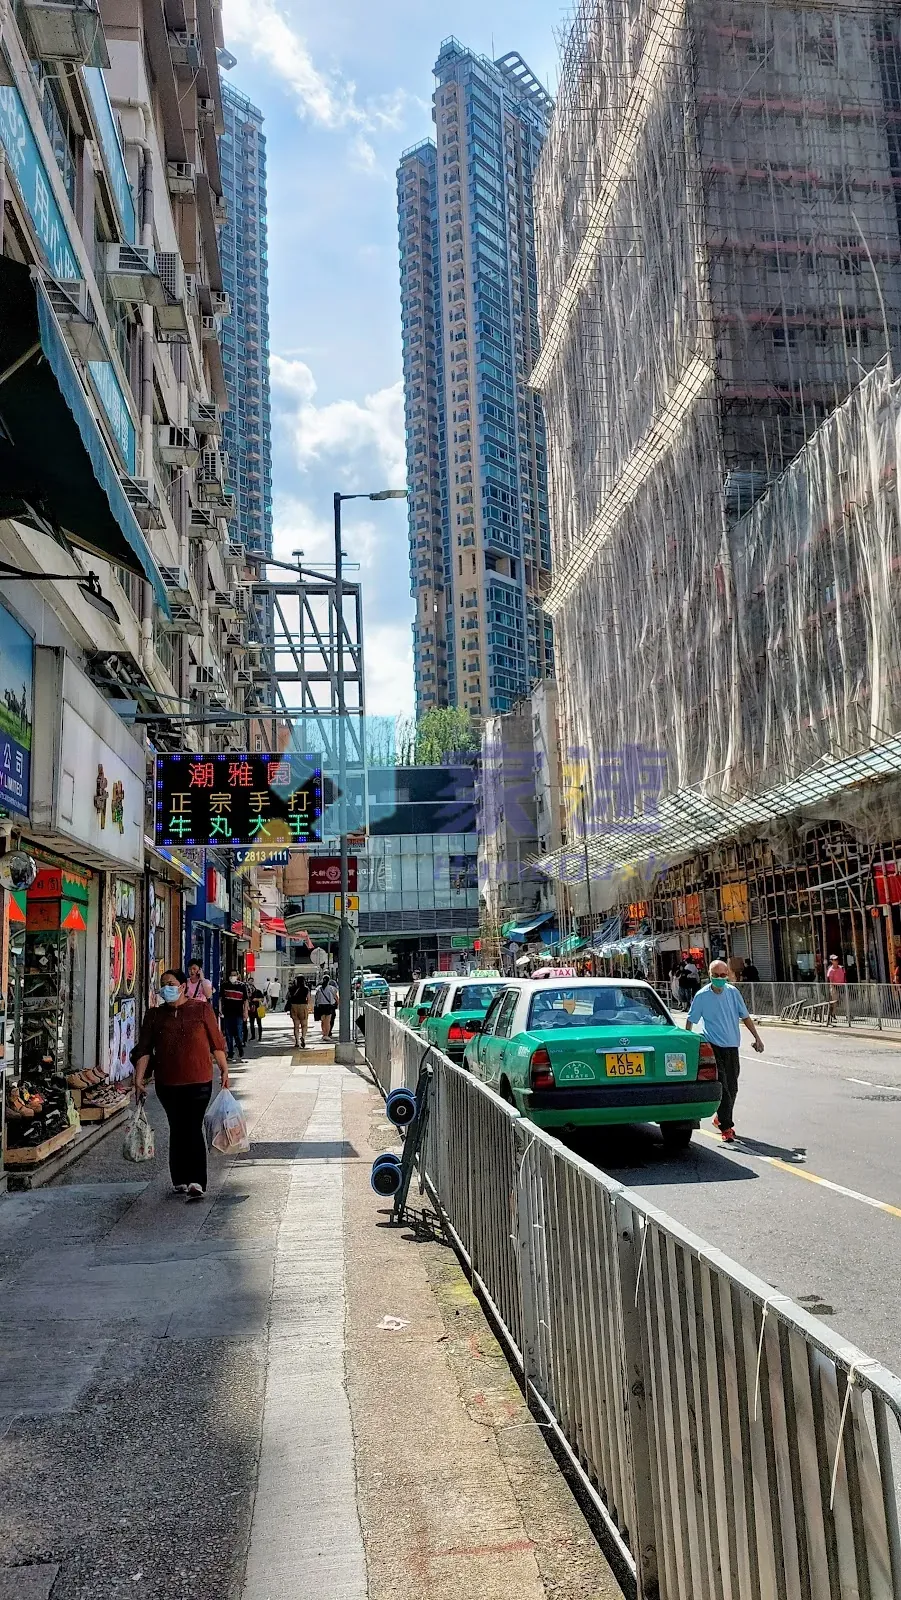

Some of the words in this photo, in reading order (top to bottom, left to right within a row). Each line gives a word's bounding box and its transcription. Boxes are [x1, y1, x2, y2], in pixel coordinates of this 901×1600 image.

[4, 743, 23, 778] 公司
[4, 774, 23, 797] LIMITED
[188, 762, 291, 788] 潮雅園
[169, 790, 311, 813] 正宗手打
[169, 814, 310, 838] 牛丸大王
[244, 850, 266, 862] 2813
[268, 849, 287, 861] 1111
[609, 1064, 643, 1075] 4054
[616, 1053, 633, 1064] KL
[574, 1066, 580, 1075] 5
